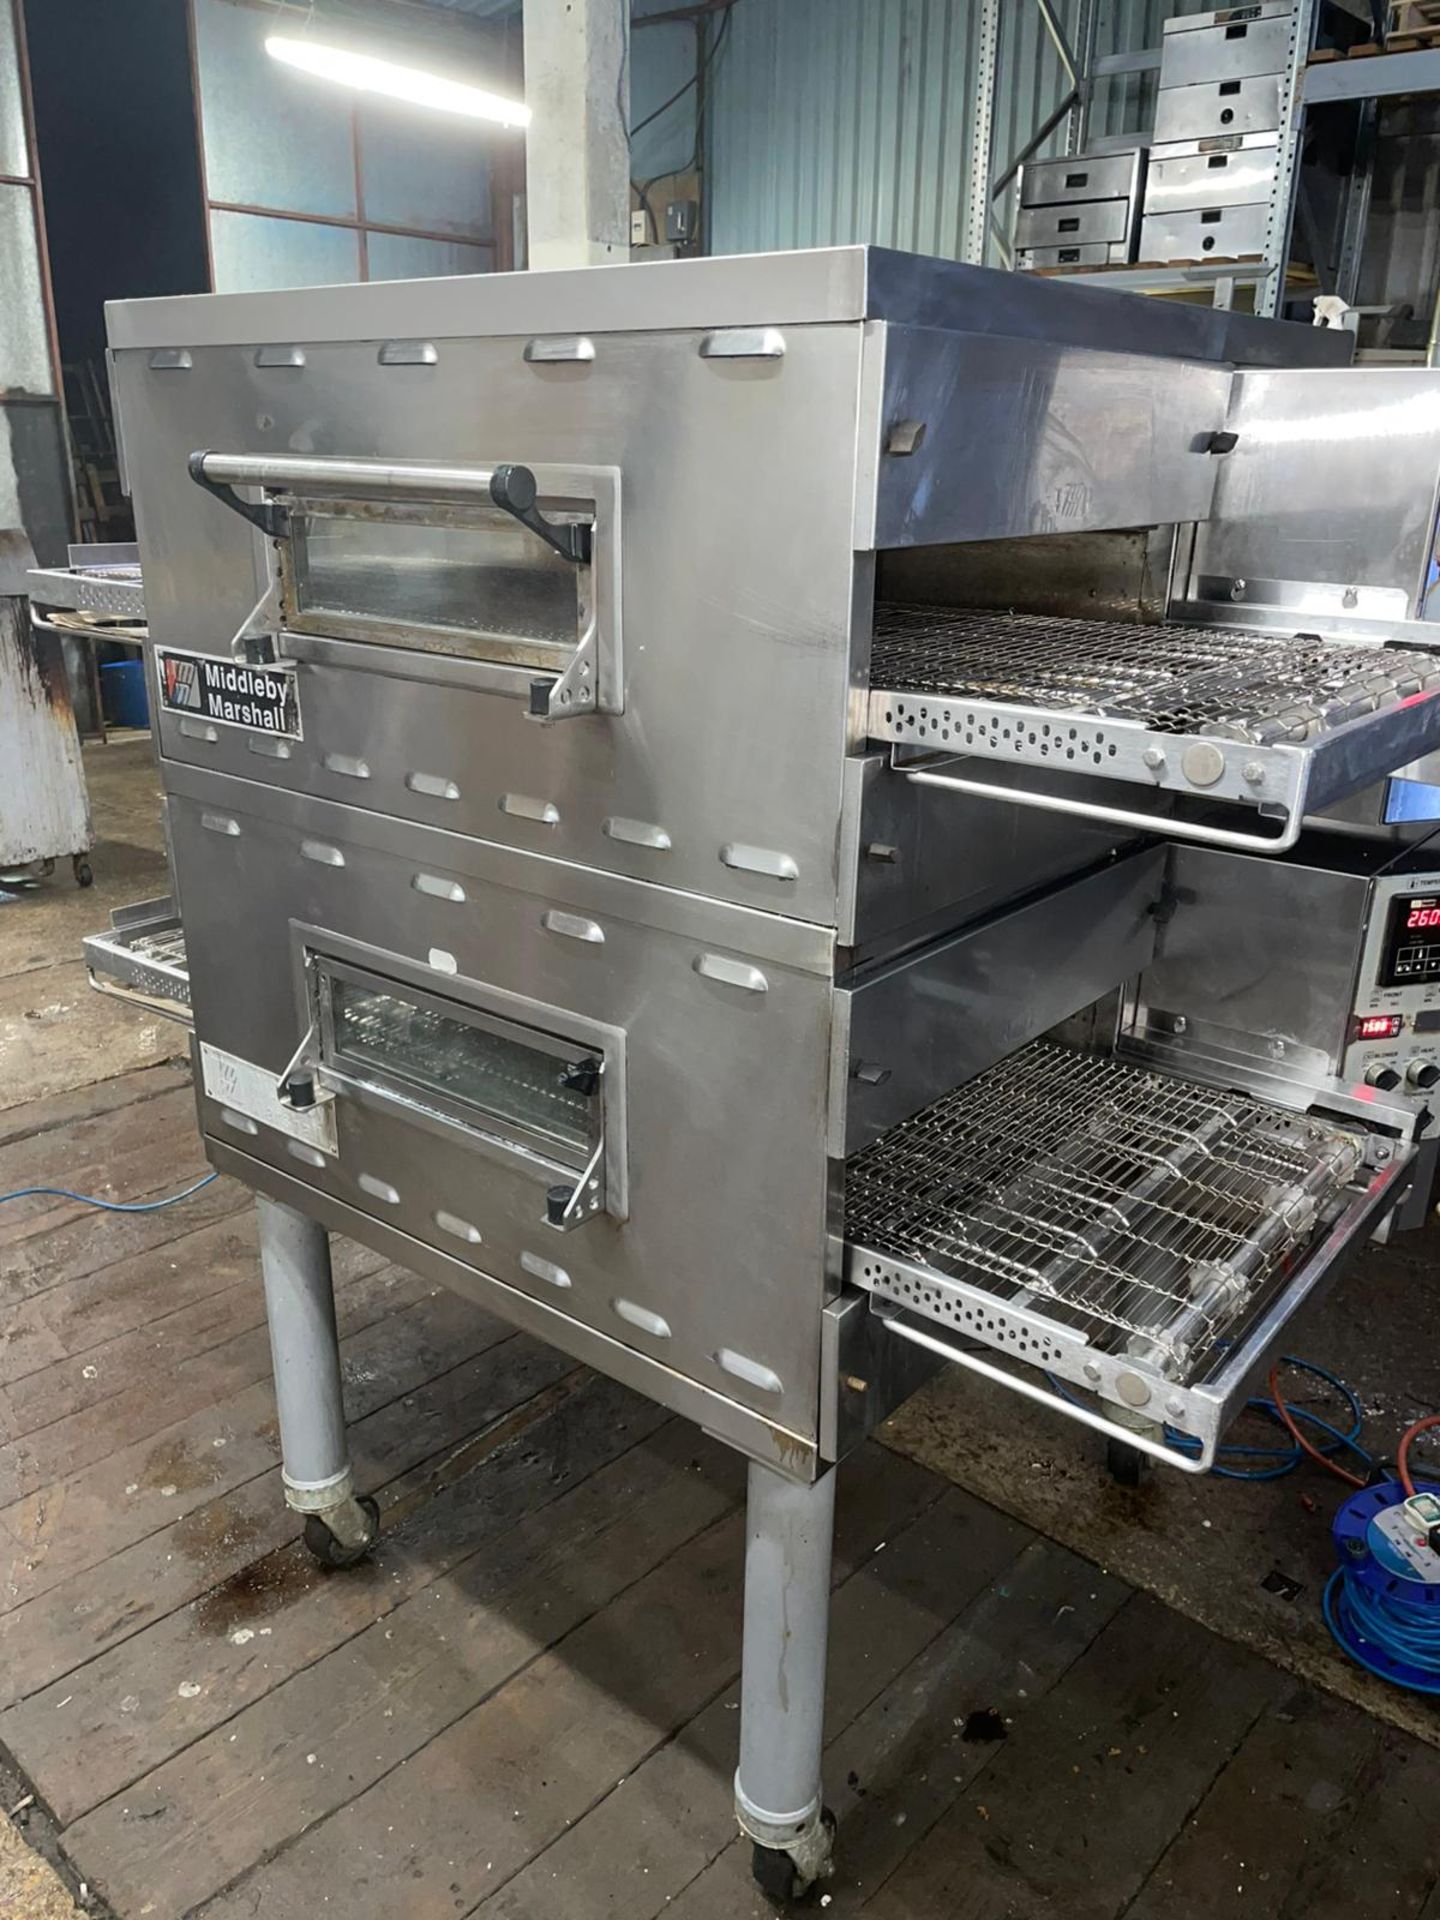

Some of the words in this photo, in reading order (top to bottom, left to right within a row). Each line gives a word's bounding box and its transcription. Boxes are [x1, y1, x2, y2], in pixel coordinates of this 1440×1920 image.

[205, 663, 287, 706] Middleby
[208, 693, 286, 731] Marshall
[1407, 909, 1440, 928] 260
